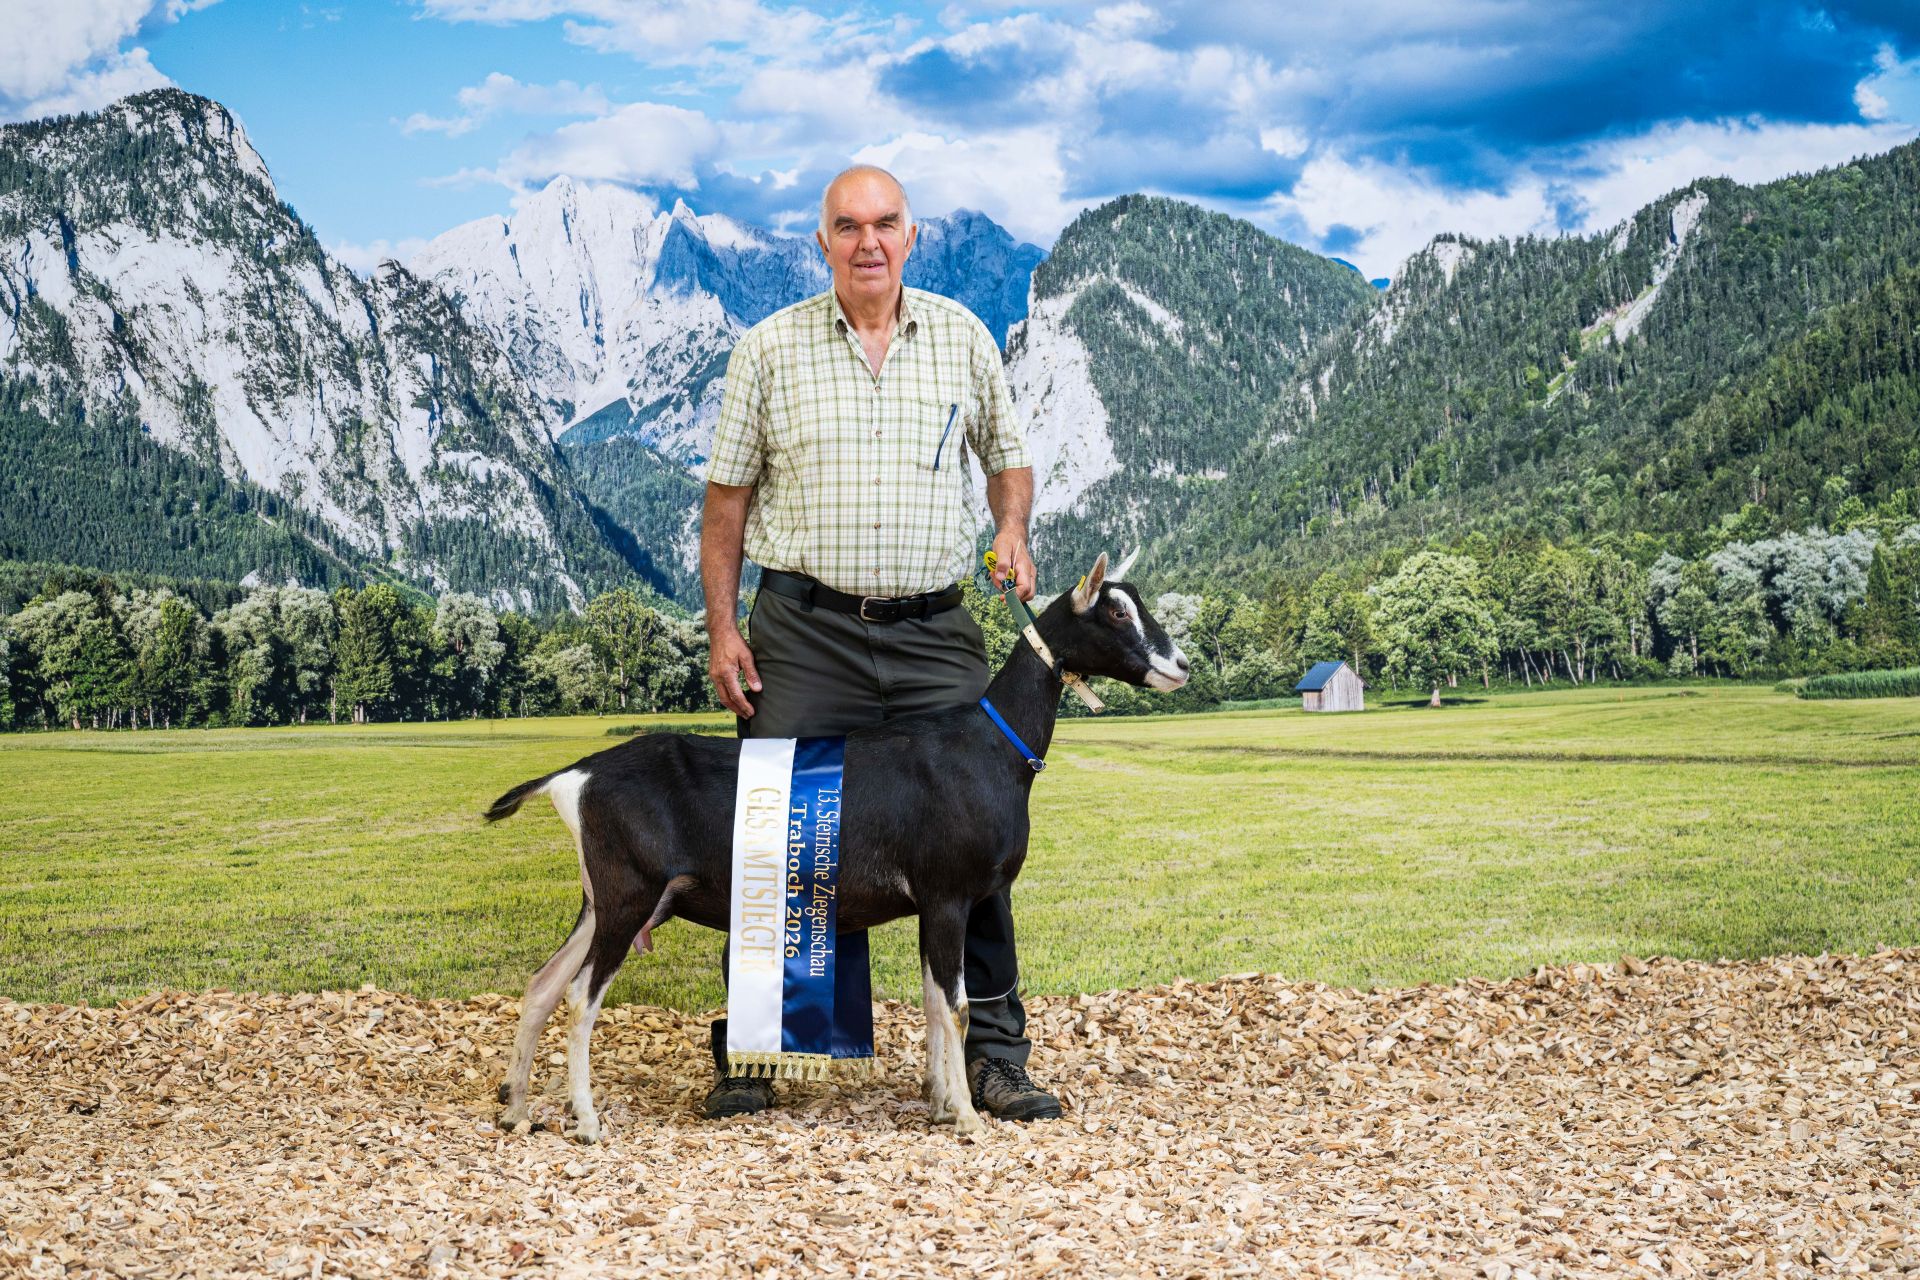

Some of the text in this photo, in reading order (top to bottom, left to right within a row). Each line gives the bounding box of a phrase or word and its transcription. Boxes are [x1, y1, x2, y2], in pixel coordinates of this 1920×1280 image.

[785, 803, 807, 958] Traboch 2026
[805, 788, 839, 976] 13. Steirische Ziegenschau
